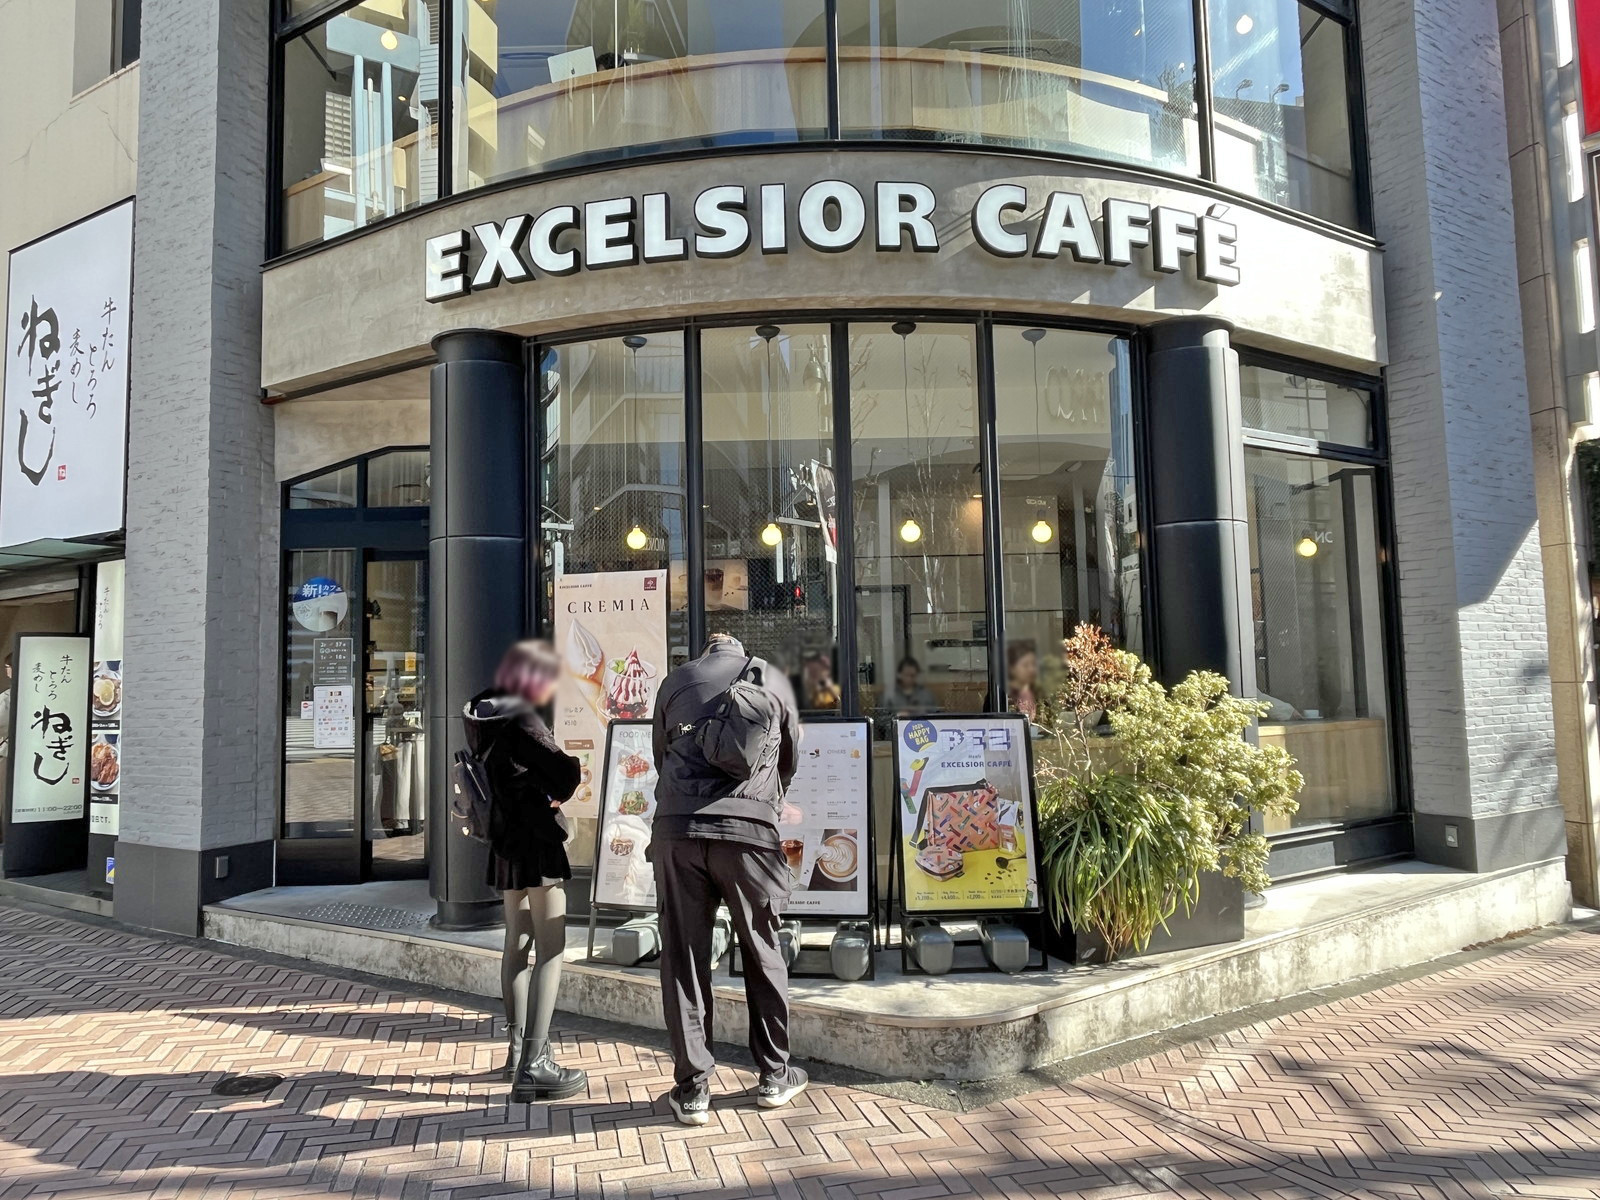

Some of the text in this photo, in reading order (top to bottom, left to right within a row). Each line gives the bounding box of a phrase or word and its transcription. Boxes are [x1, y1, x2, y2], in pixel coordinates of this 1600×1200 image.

[425, 180, 1241, 304] EXCELSIOR CAFFÉ
[101, 297, 117, 372] 牛たん
[18, 294, 63, 486] ねぎし
[70, 329, 85, 404] 麦めし
[86, 343, 98, 419] とろろ
[567, 598, 650, 614] CREMIA
[32, 662, 45, 693] 麦めし
[48, 670, 58, 700] とろろ
[60, 654, 73, 684] 牛たん
[31, 705, 74, 785] ねぎし
[908, 727, 930, 739] HAPPY
[915, 735, 929, 745] BAG
